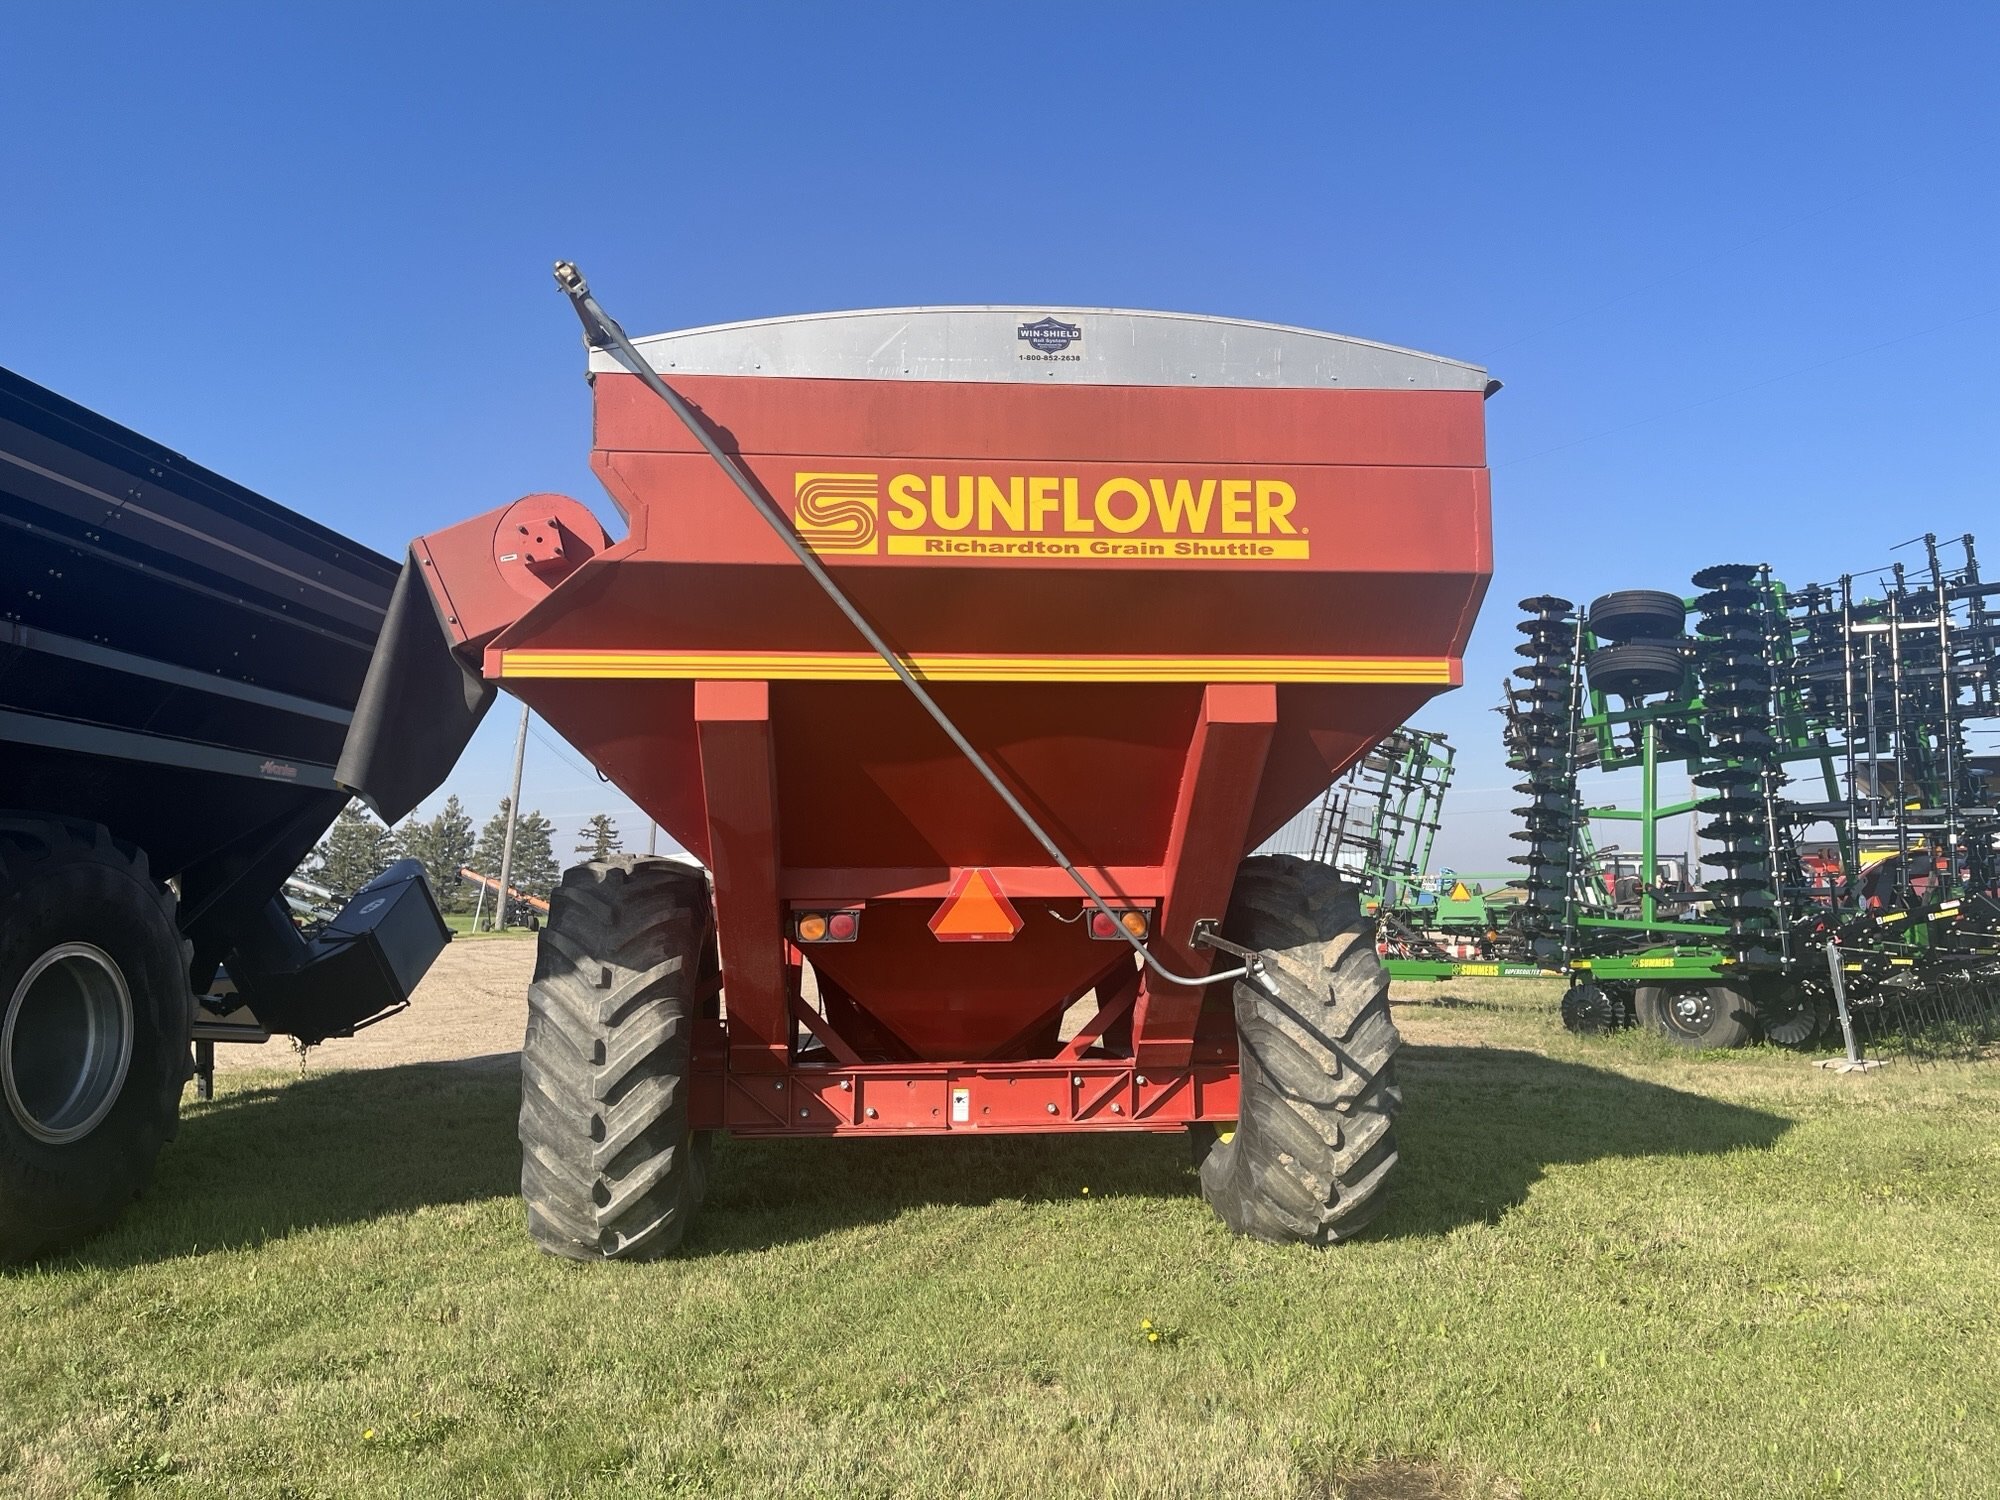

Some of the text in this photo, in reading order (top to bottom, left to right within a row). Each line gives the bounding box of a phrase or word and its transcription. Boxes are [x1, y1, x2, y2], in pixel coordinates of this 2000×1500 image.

[888, 474, 1298, 534] SUNFLOWER
[925, 539, 1275, 556] Richardton Grain Shuttle
[1461, 964, 1499, 976] SUMMERS
[1640, 958, 1674, 968] SUMMERS
